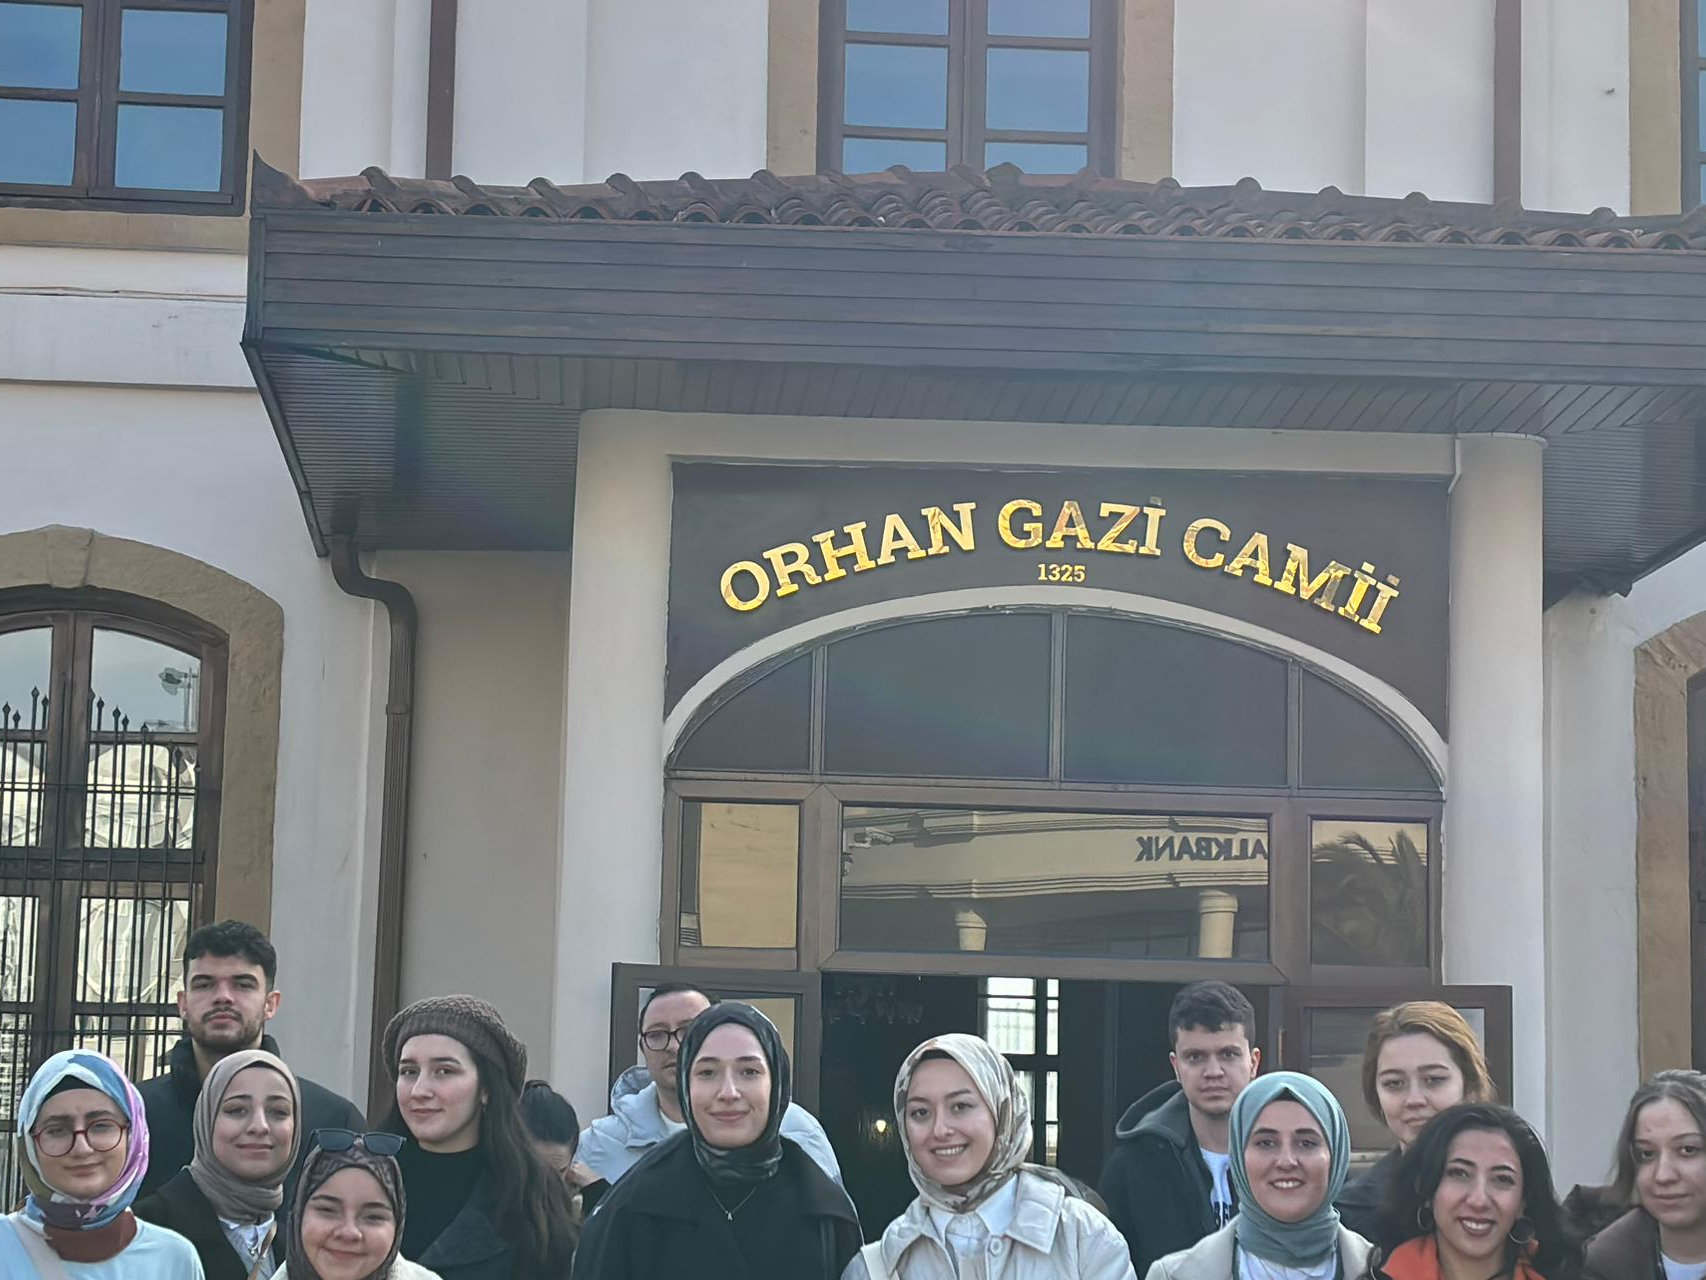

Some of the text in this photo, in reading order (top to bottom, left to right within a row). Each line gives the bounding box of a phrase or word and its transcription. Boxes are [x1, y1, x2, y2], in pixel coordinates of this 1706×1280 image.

[719, 496, 1401, 635] ORHAN GAZİ CAMİİ
[1037, 563, 1086, 582] 1325
